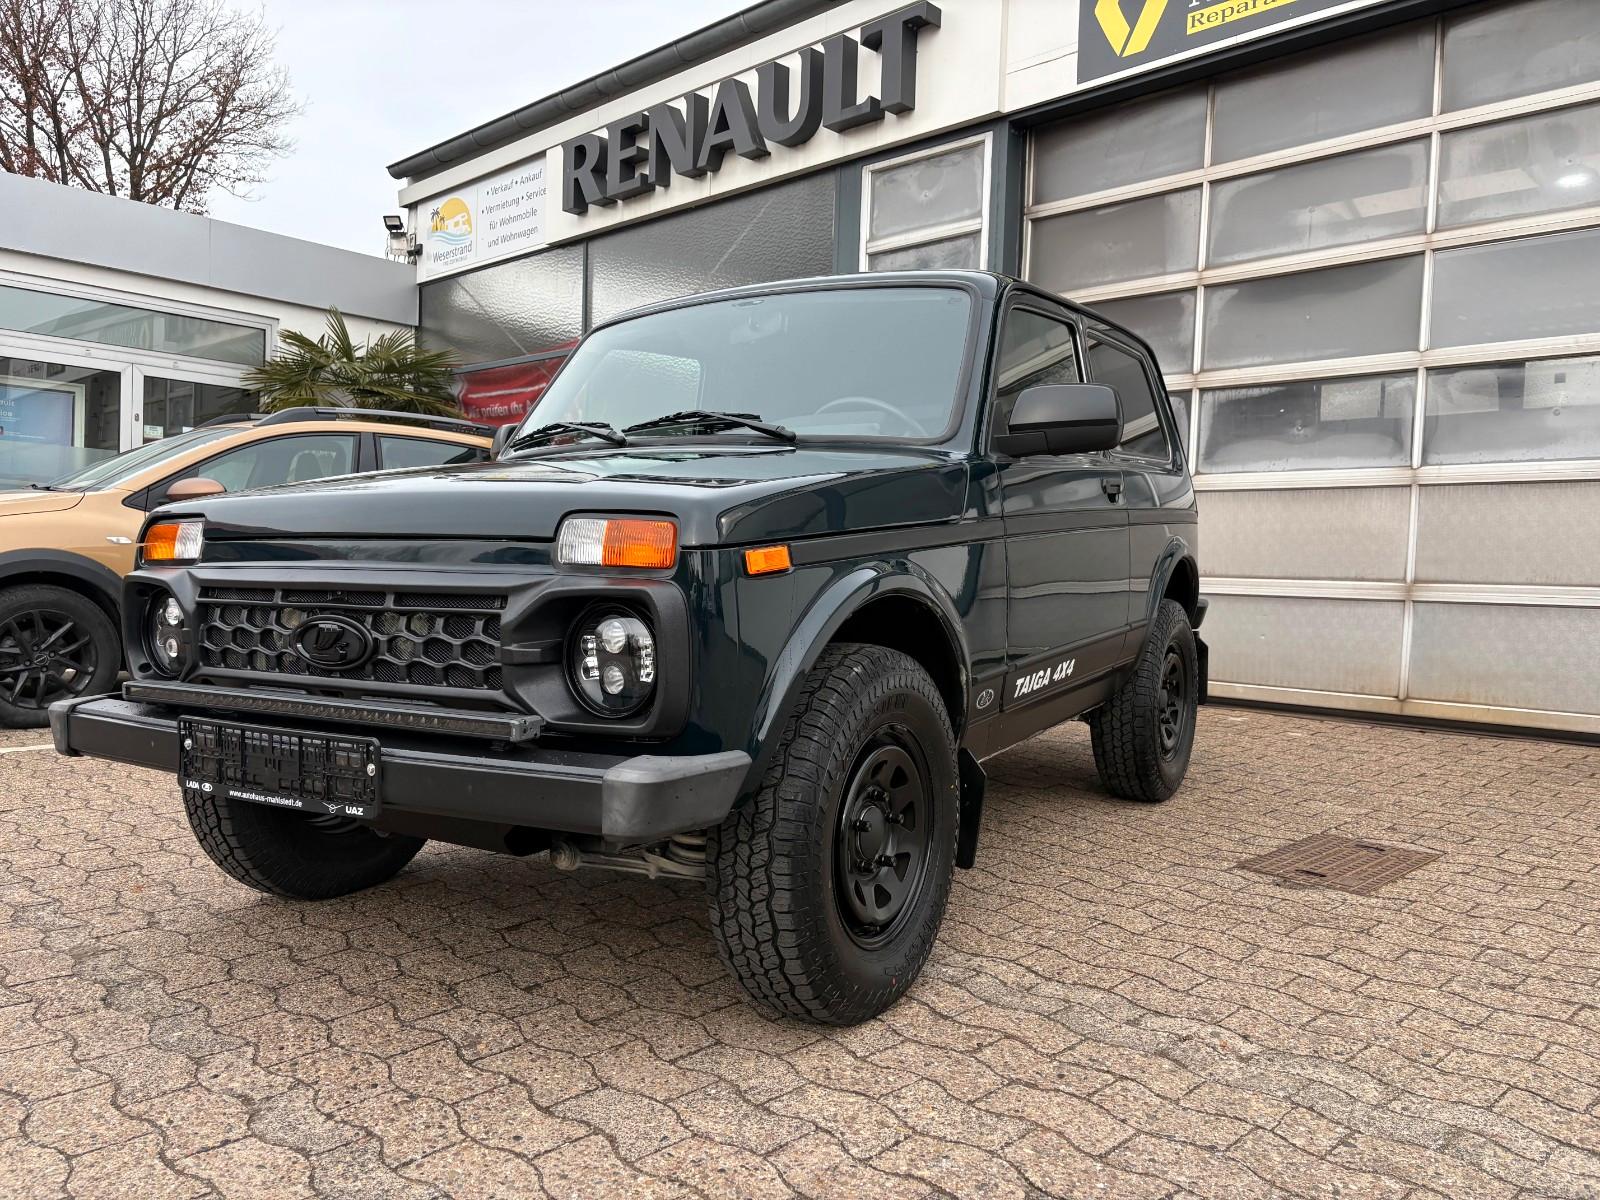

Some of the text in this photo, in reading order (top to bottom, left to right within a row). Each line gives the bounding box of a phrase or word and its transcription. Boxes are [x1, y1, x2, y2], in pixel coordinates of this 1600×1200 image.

[561, 1, 941, 215] RENAULT
[490, 168, 543, 195] Verkauf Ankauf
[486, 187, 547, 215] Vermietung Service
[489, 207, 538, 231] für Wohnmobile
[487, 226, 538, 248] und Wohnwagen
[433, 241, 472, 263] Weserstrand
[480, 403, 509, 420] prüfen
[1014, 659, 1075, 698] TAIGA 4X4
[186, 779, 200, 790] LADA
[229, 790, 303, 807] www.autohaus-mahlstedt.de
[345, 805, 364, 816] UAZ
